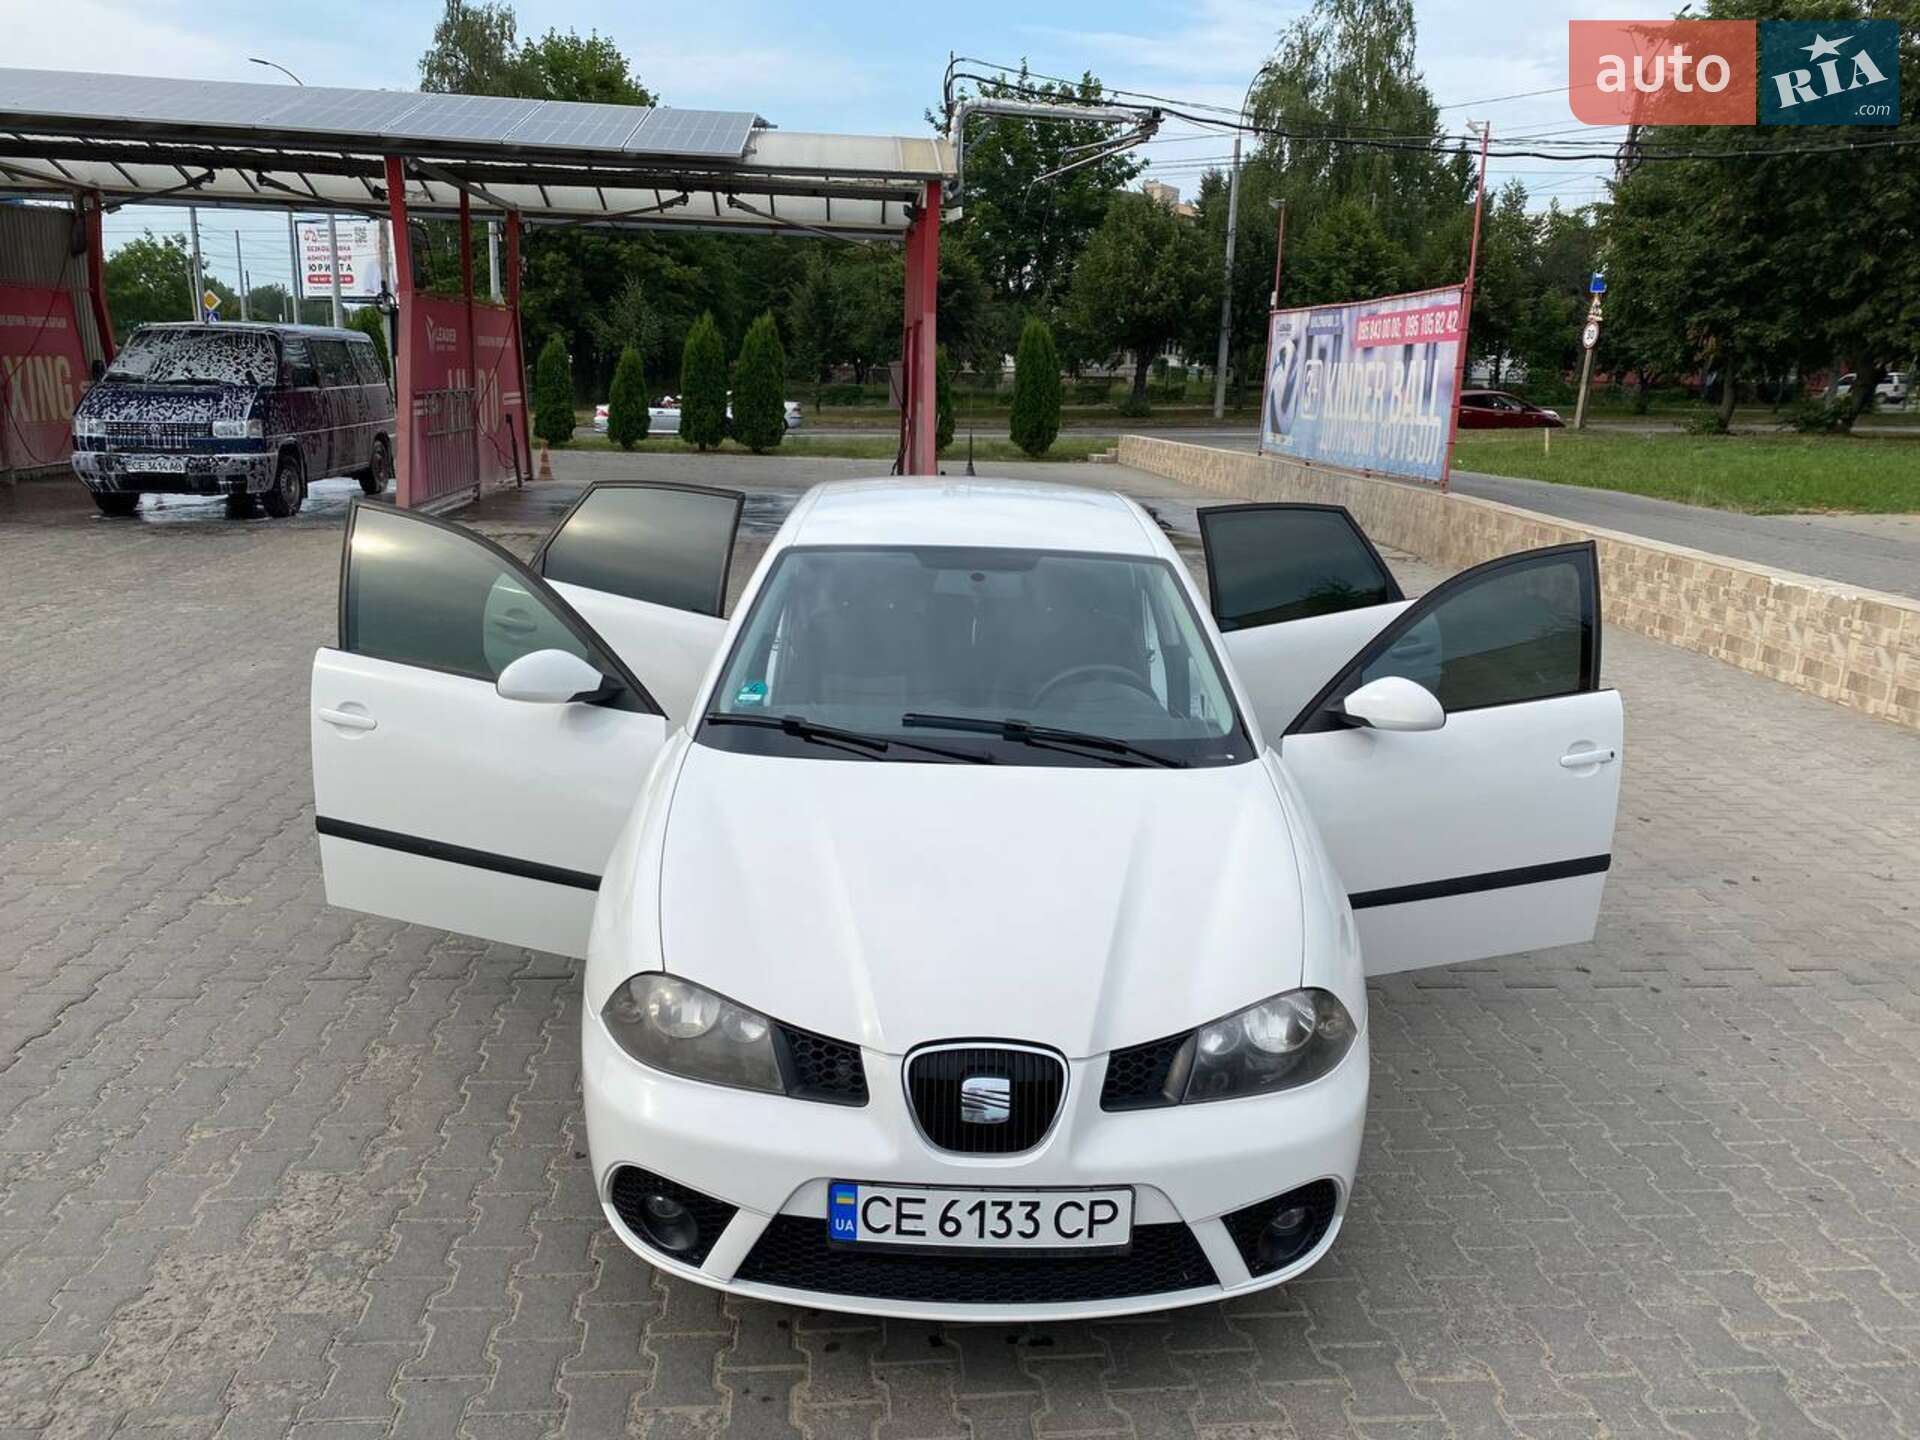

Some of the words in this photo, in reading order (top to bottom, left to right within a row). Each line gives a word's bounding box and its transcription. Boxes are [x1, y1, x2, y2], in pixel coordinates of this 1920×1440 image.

[308, 263, 353, 272] ЮРИТА
[1323, 361, 1386, 421] KINDER
[1389, 360, 1440, 425] BALL
[835, 1218, 854, 1231] UA
[861, 1195, 926, 1237] CE
[938, 1200, 1040, 1239] 6133
[1054, 1200, 1119, 1239] CP
